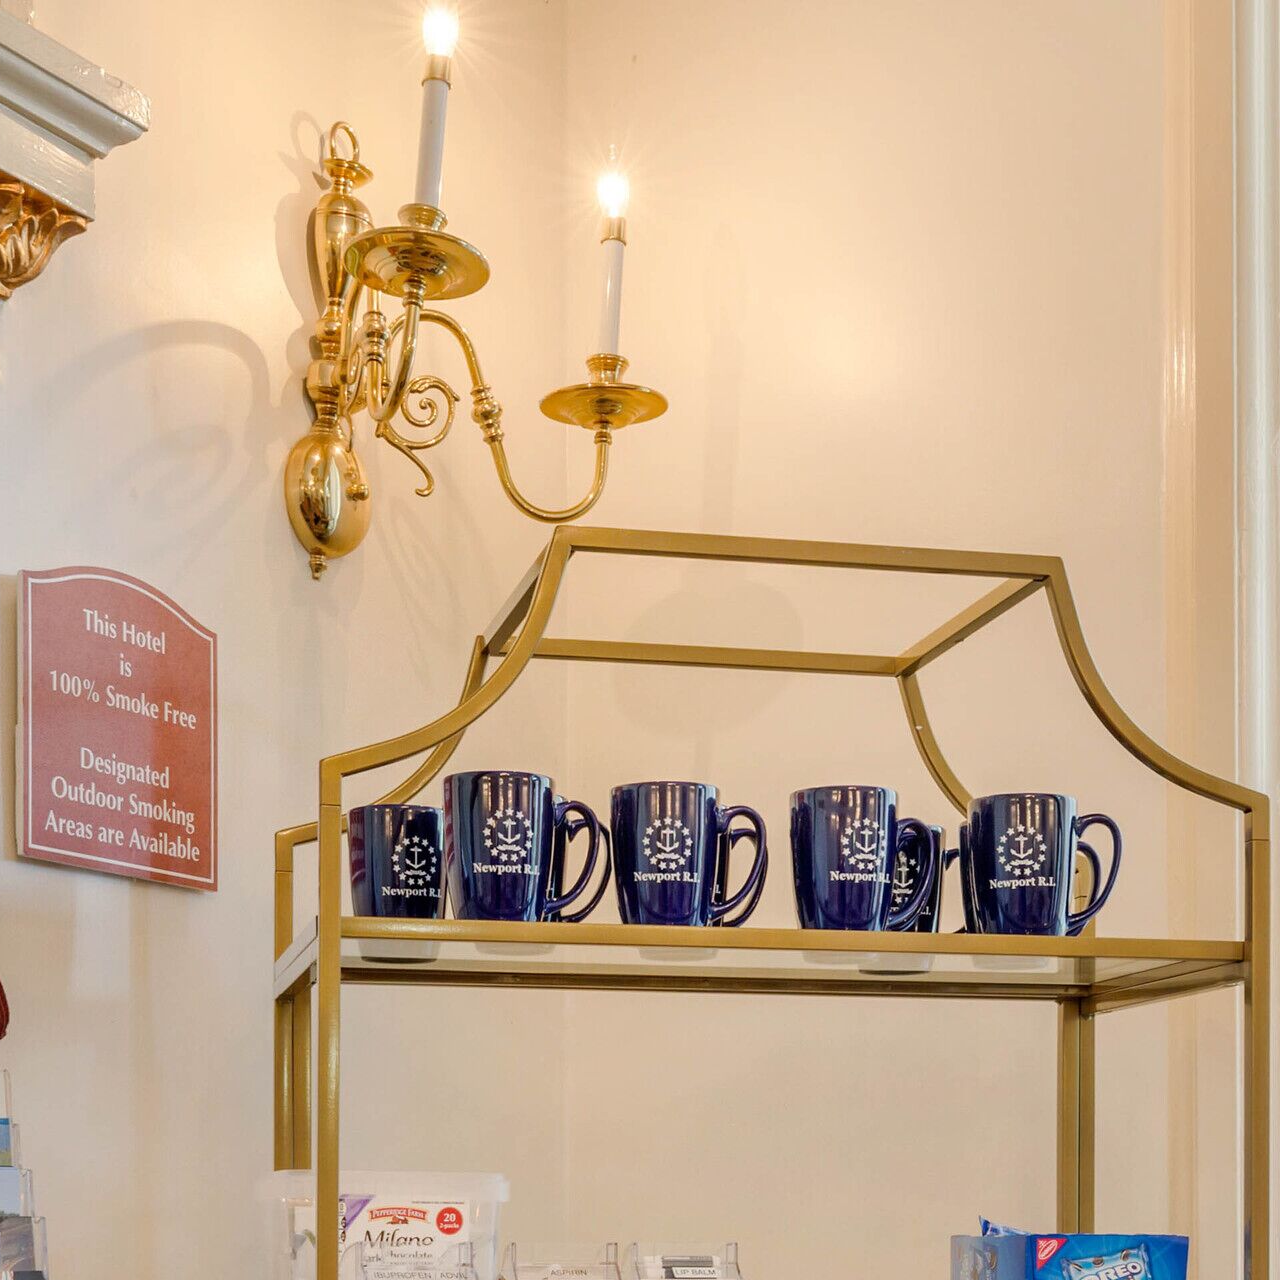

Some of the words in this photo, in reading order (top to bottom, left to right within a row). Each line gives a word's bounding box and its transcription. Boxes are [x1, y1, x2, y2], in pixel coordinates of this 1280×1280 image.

[83, 608, 117, 639] This
[122, 618, 166, 655] Hotel
[119, 653, 132, 678] is
[49, 670, 100, 704] 100%
[106, 685, 159, 719] Smoke
[164, 702, 197, 730] Free
[80, 747, 170, 789] Designated
[51, 776, 124, 811] Outdoor
[129, 794, 195, 834] Smoking
[45, 810, 93, 839] Areas
[98, 825, 124, 846] are
[129, 831, 200, 862] Available
[473, 863, 522, 876] Newport
[634, 872, 680, 884] Newport
[830, 871, 877, 883] Newport
[990, 877, 1036, 889] Newport
[382, 886, 427, 898] Newport
[443, 1213, 456, 1222] 20
[364, 1229, 434, 1248] Milano
[550, 1268, 588, 1277] ASPIRIN
[675, 1268, 690, 1276] LIP
[692, 1268, 717, 1276] BALM
